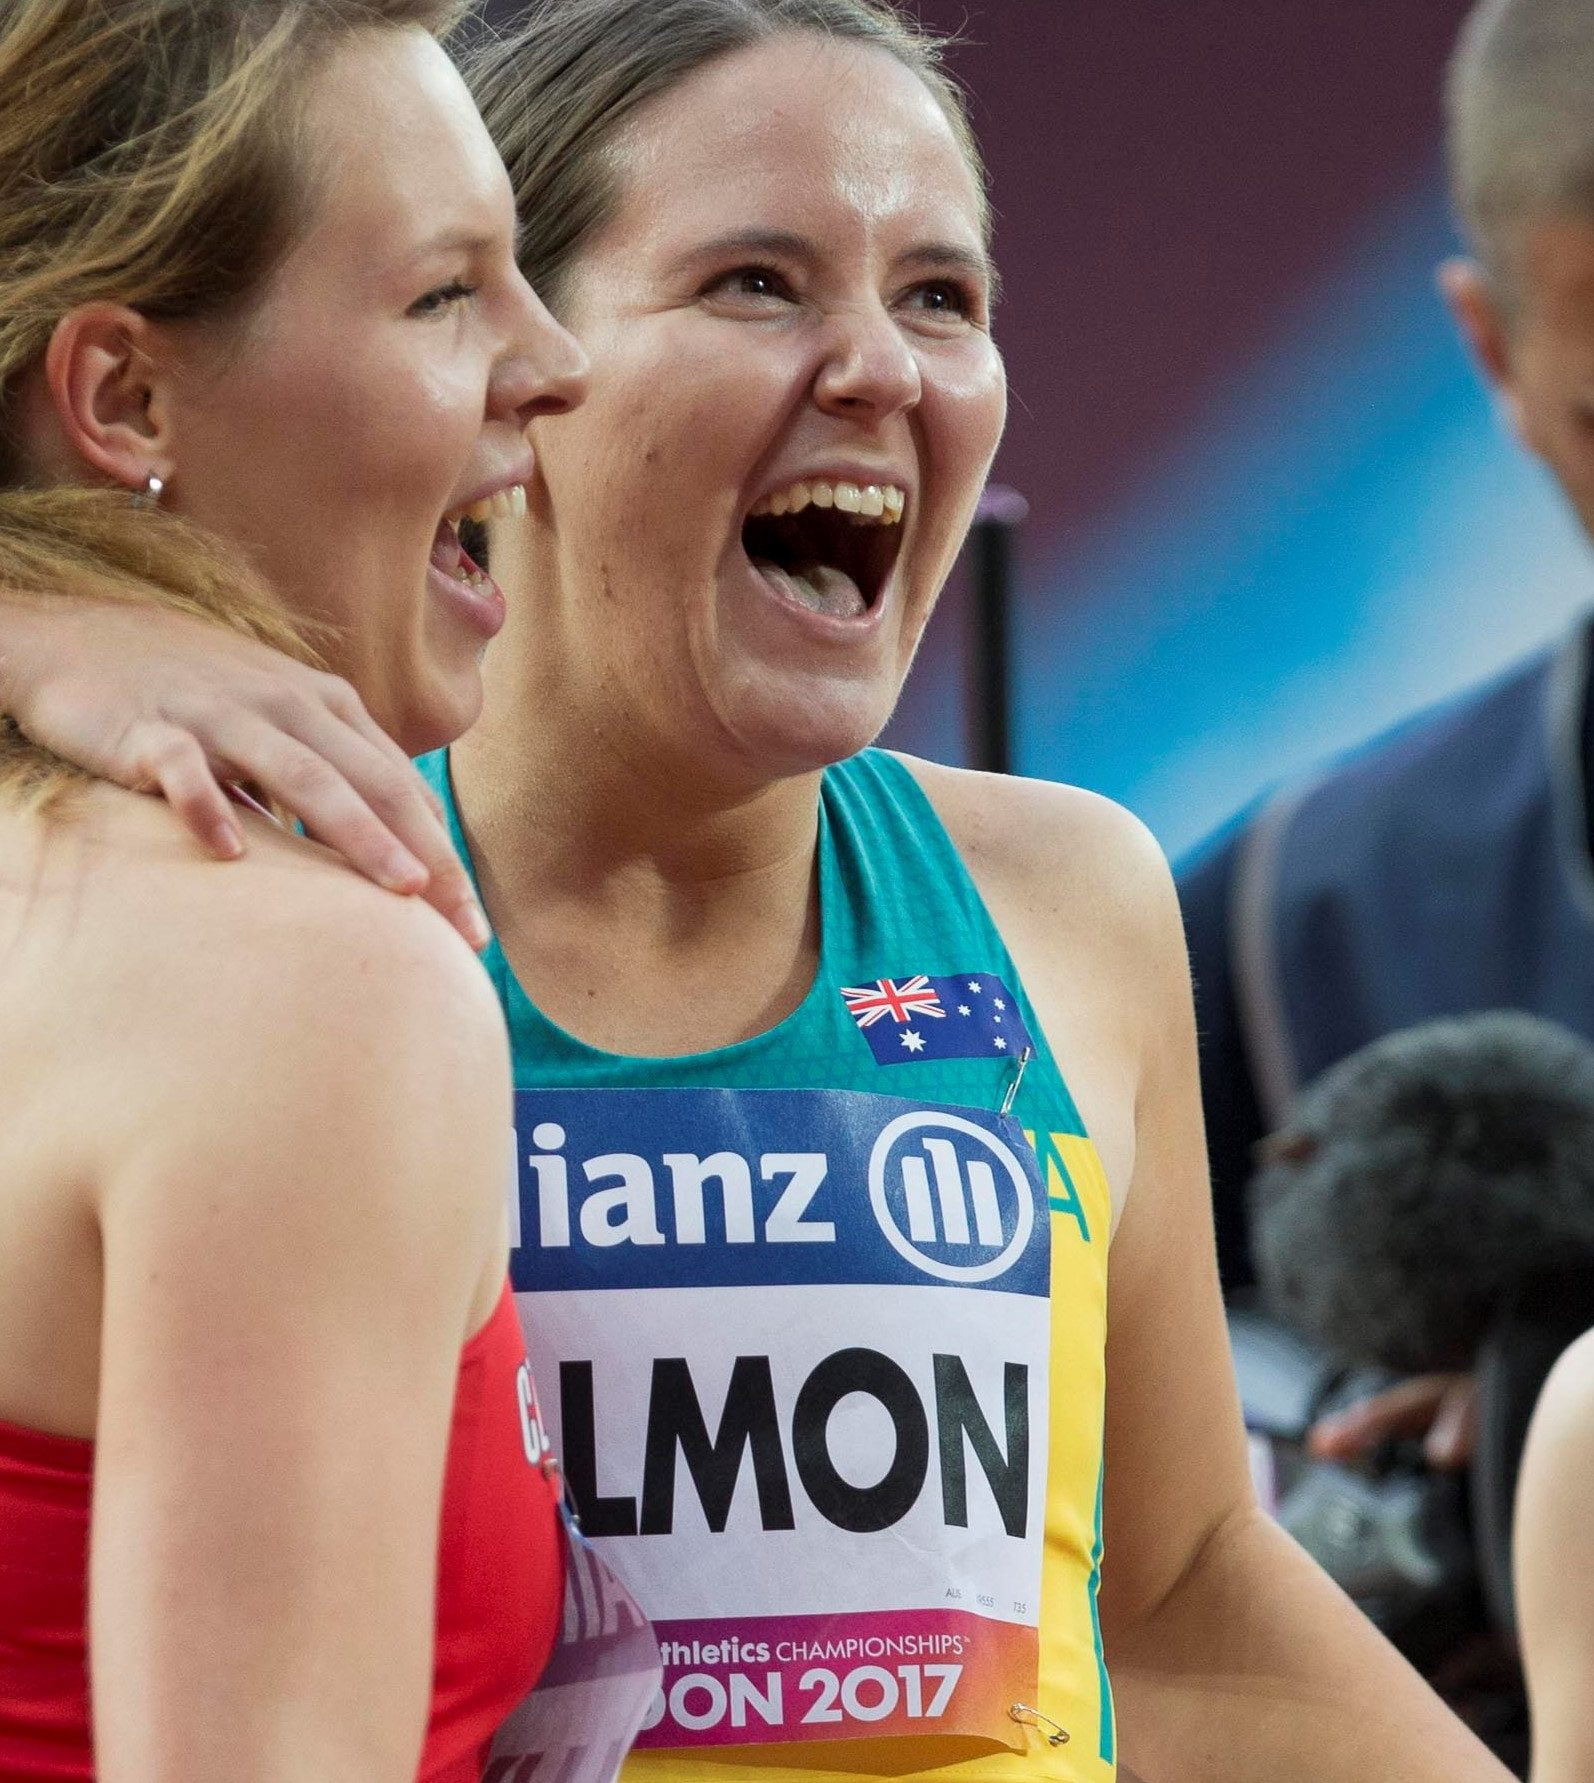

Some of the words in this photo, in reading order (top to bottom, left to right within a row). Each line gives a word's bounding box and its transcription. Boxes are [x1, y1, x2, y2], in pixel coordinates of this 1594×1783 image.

[559, 1346, 1029, 1539] LMON
[775, 1634, 964, 1663] CHAMPIONSHIPS
[799, 1664, 964, 1724] 2017
